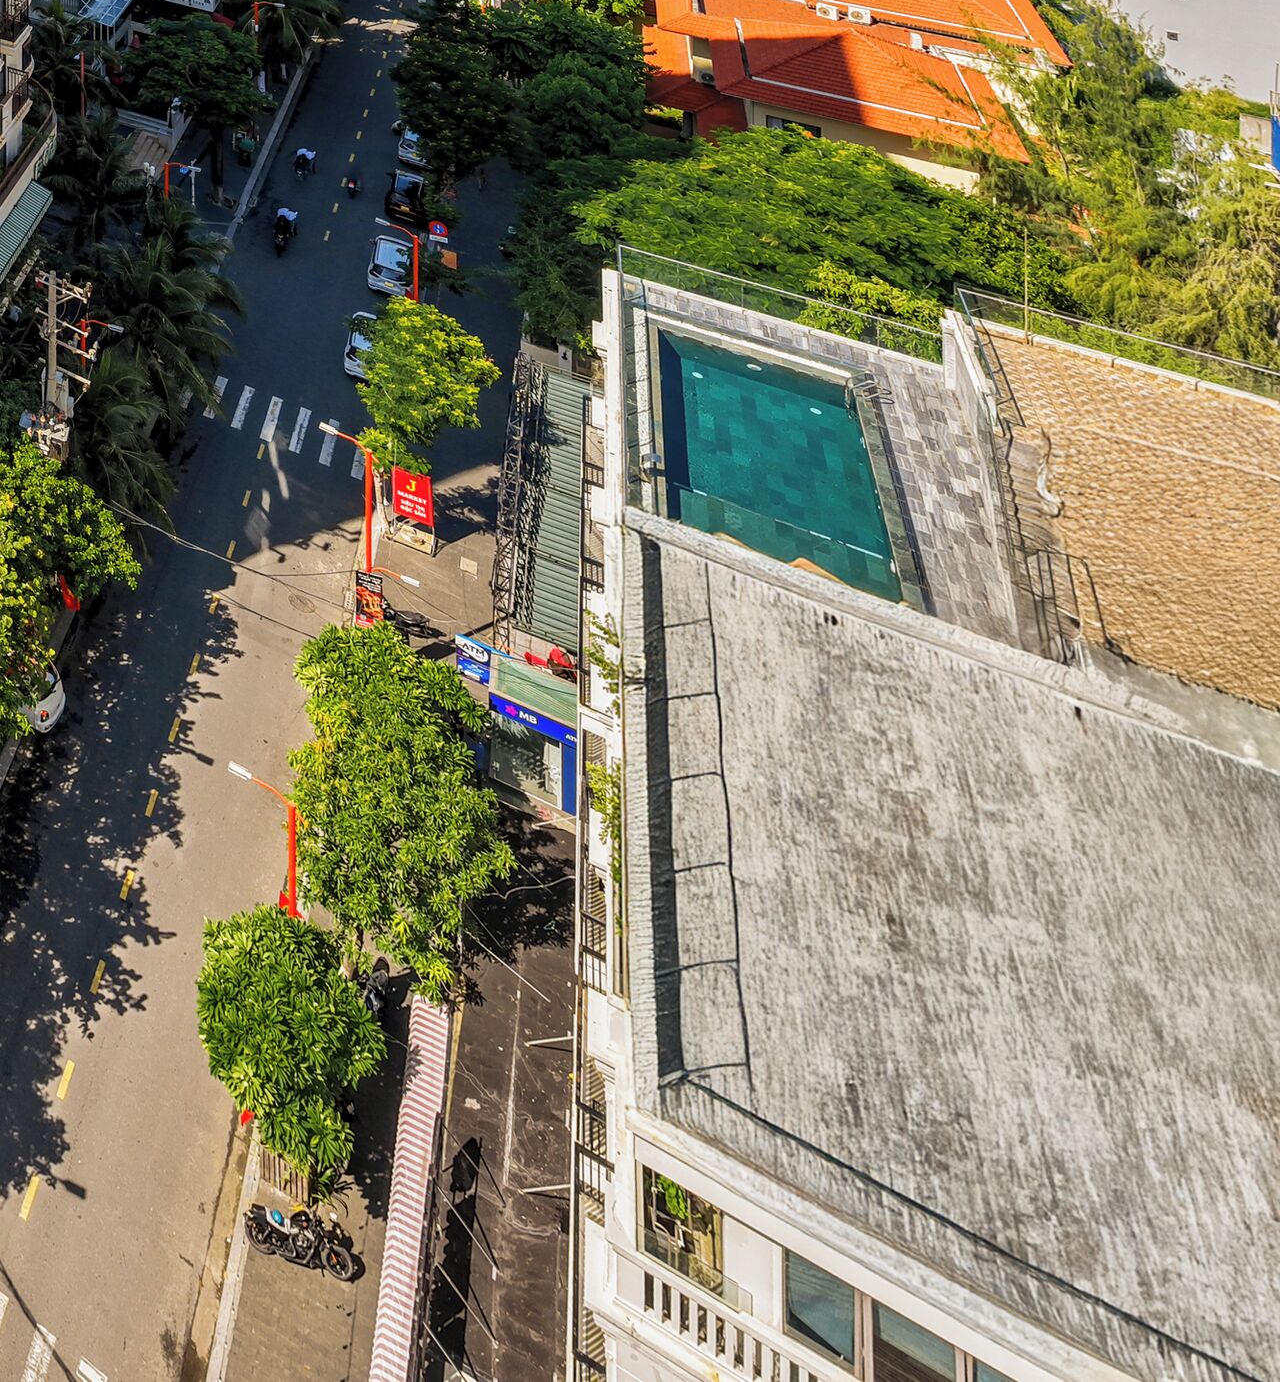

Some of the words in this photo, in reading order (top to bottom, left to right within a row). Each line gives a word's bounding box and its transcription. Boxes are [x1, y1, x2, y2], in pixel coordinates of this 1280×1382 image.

[397, 489, 428, 505] MARKET
[461, 642, 485, 657] ATM
[519, 710, 538, 725] MB
